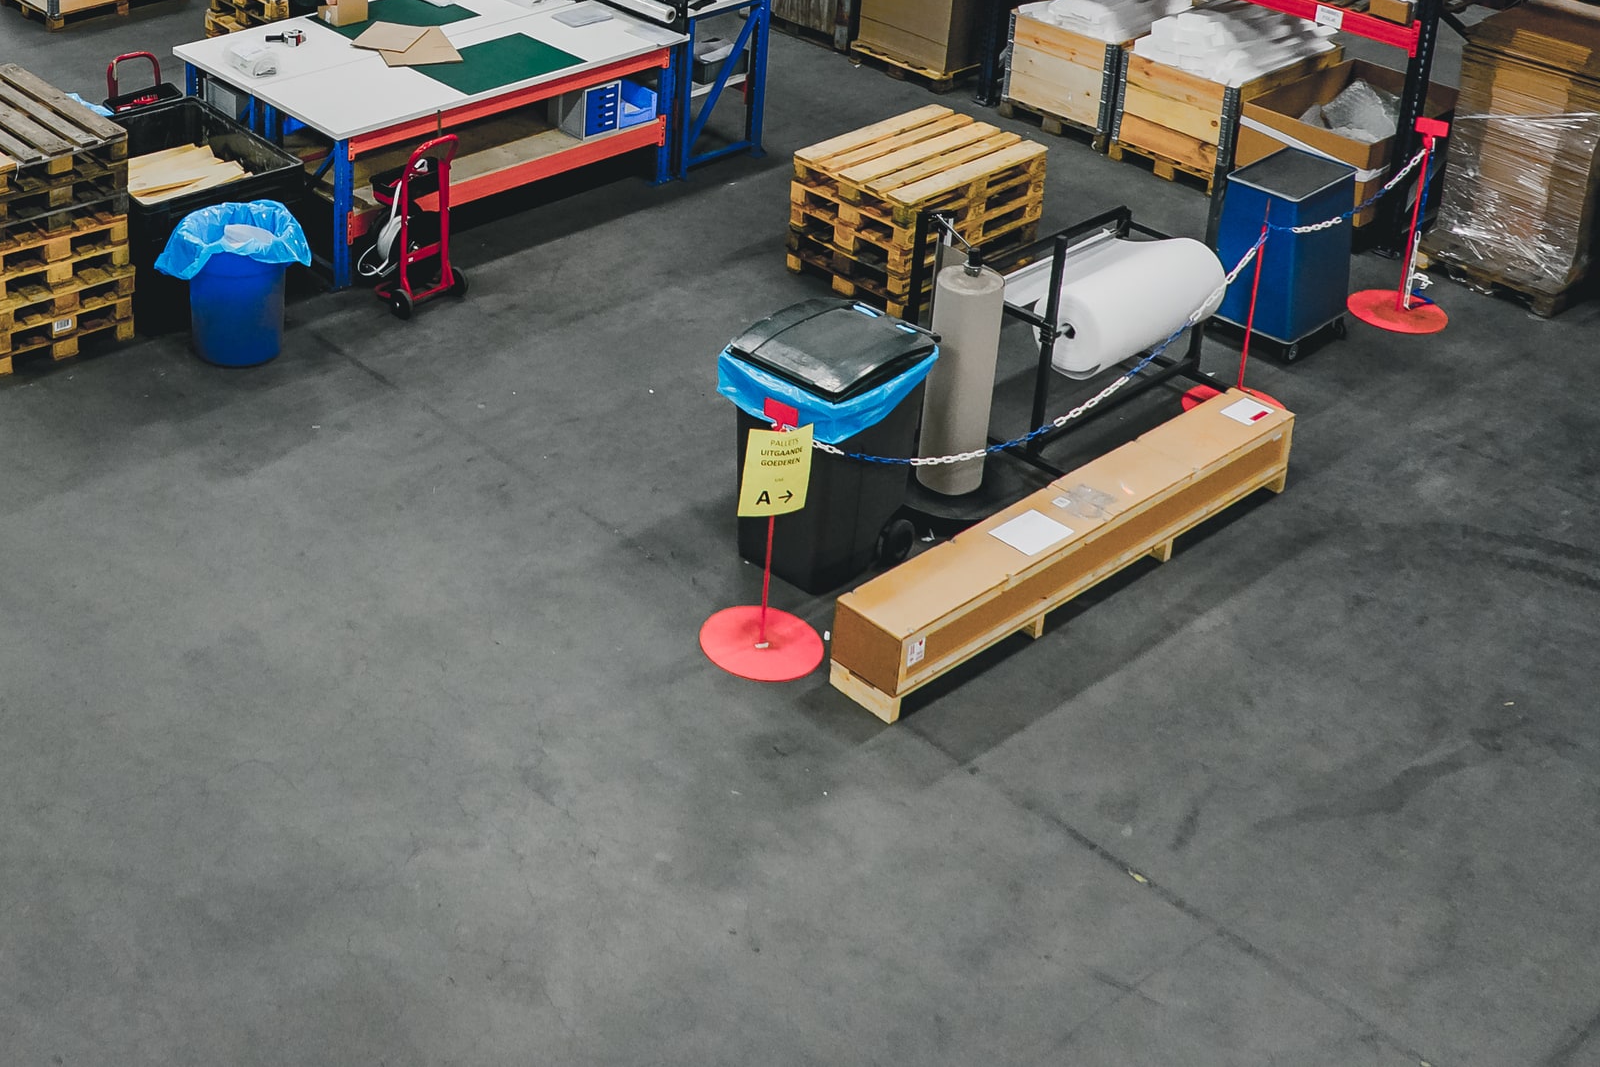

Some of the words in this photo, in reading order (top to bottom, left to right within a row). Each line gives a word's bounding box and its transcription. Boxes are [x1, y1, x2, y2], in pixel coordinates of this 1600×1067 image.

[770, 438, 799, 446] PALLETS
[760, 446, 804, 456] UITGAANDE
[760, 457, 801, 466] GOEDEREN
[756, 490, 771, 505] A
